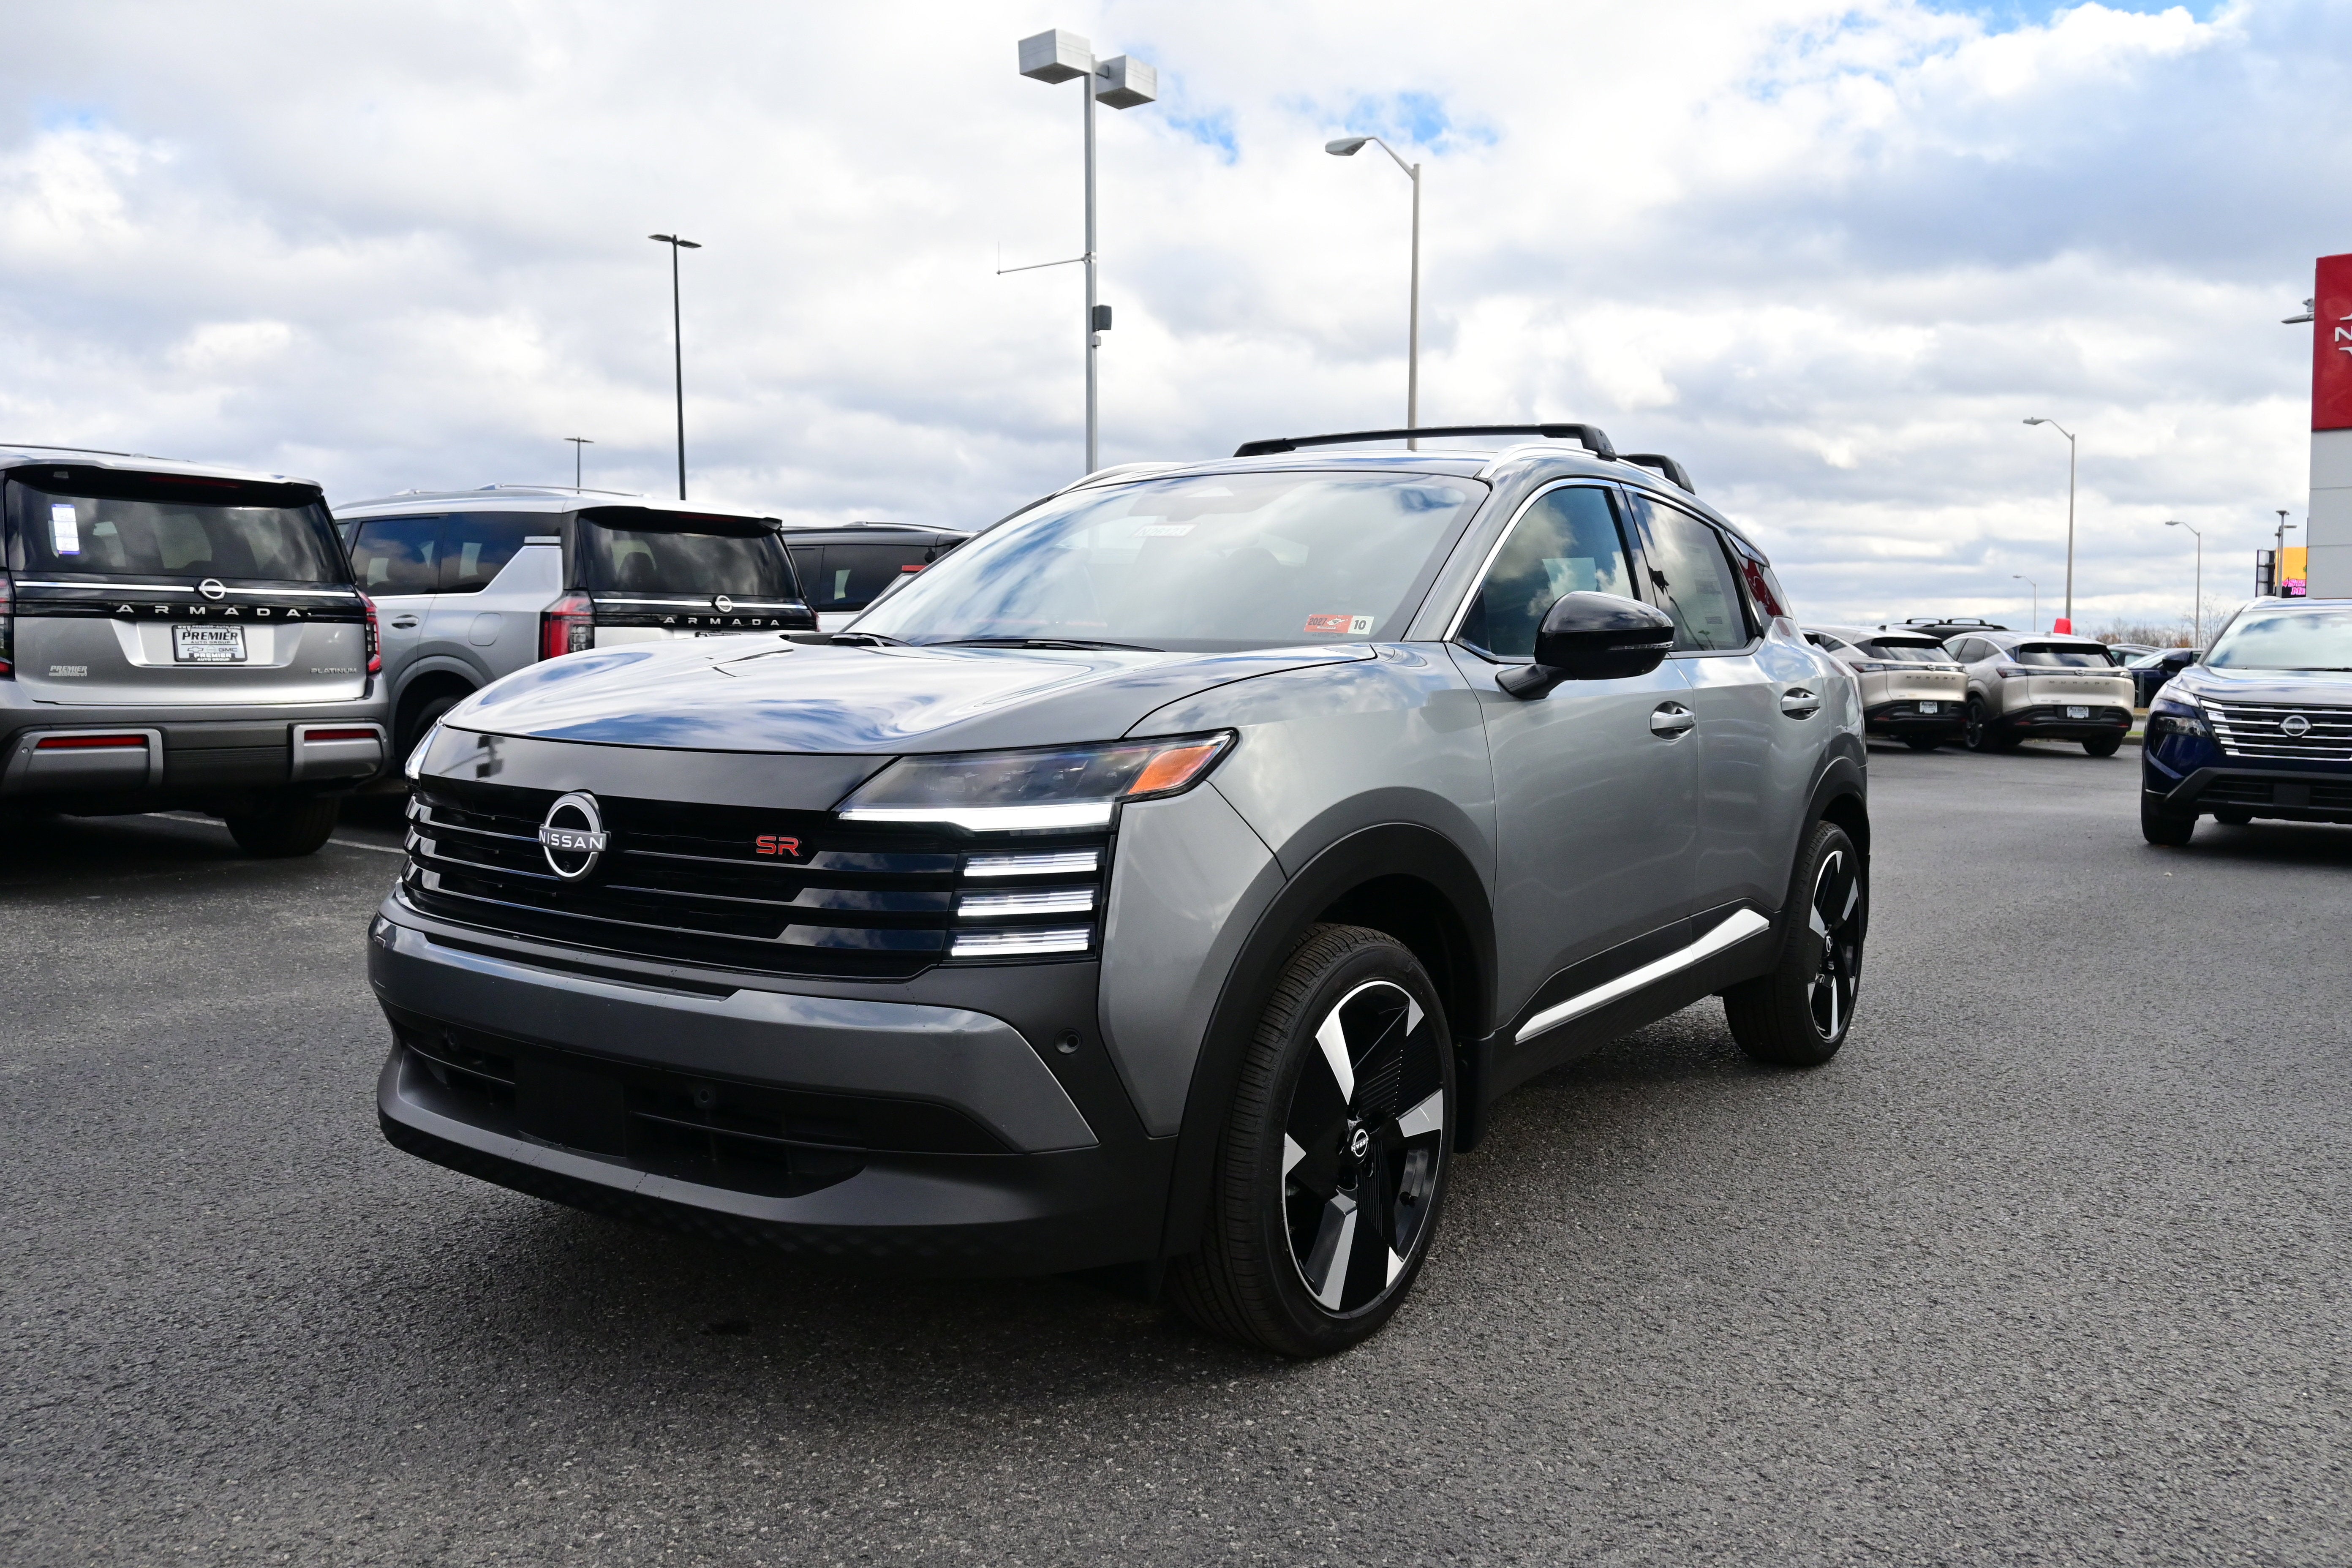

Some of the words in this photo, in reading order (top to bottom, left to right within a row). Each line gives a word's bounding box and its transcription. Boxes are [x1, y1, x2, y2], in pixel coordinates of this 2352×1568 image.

[116, 604, 301, 617] ARMADA
[663, 617, 780, 626] ARMADA
[1308, 617, 1328, 626] 2027
[1354, 620, 1367, 630] 10
[182, 632, 238, 641] PREMIER
[539, 830, 603, 849] NISSAN
[756, 835, 799, 856] SR
[1351, 1135, 1369, 1152] NISSAN
